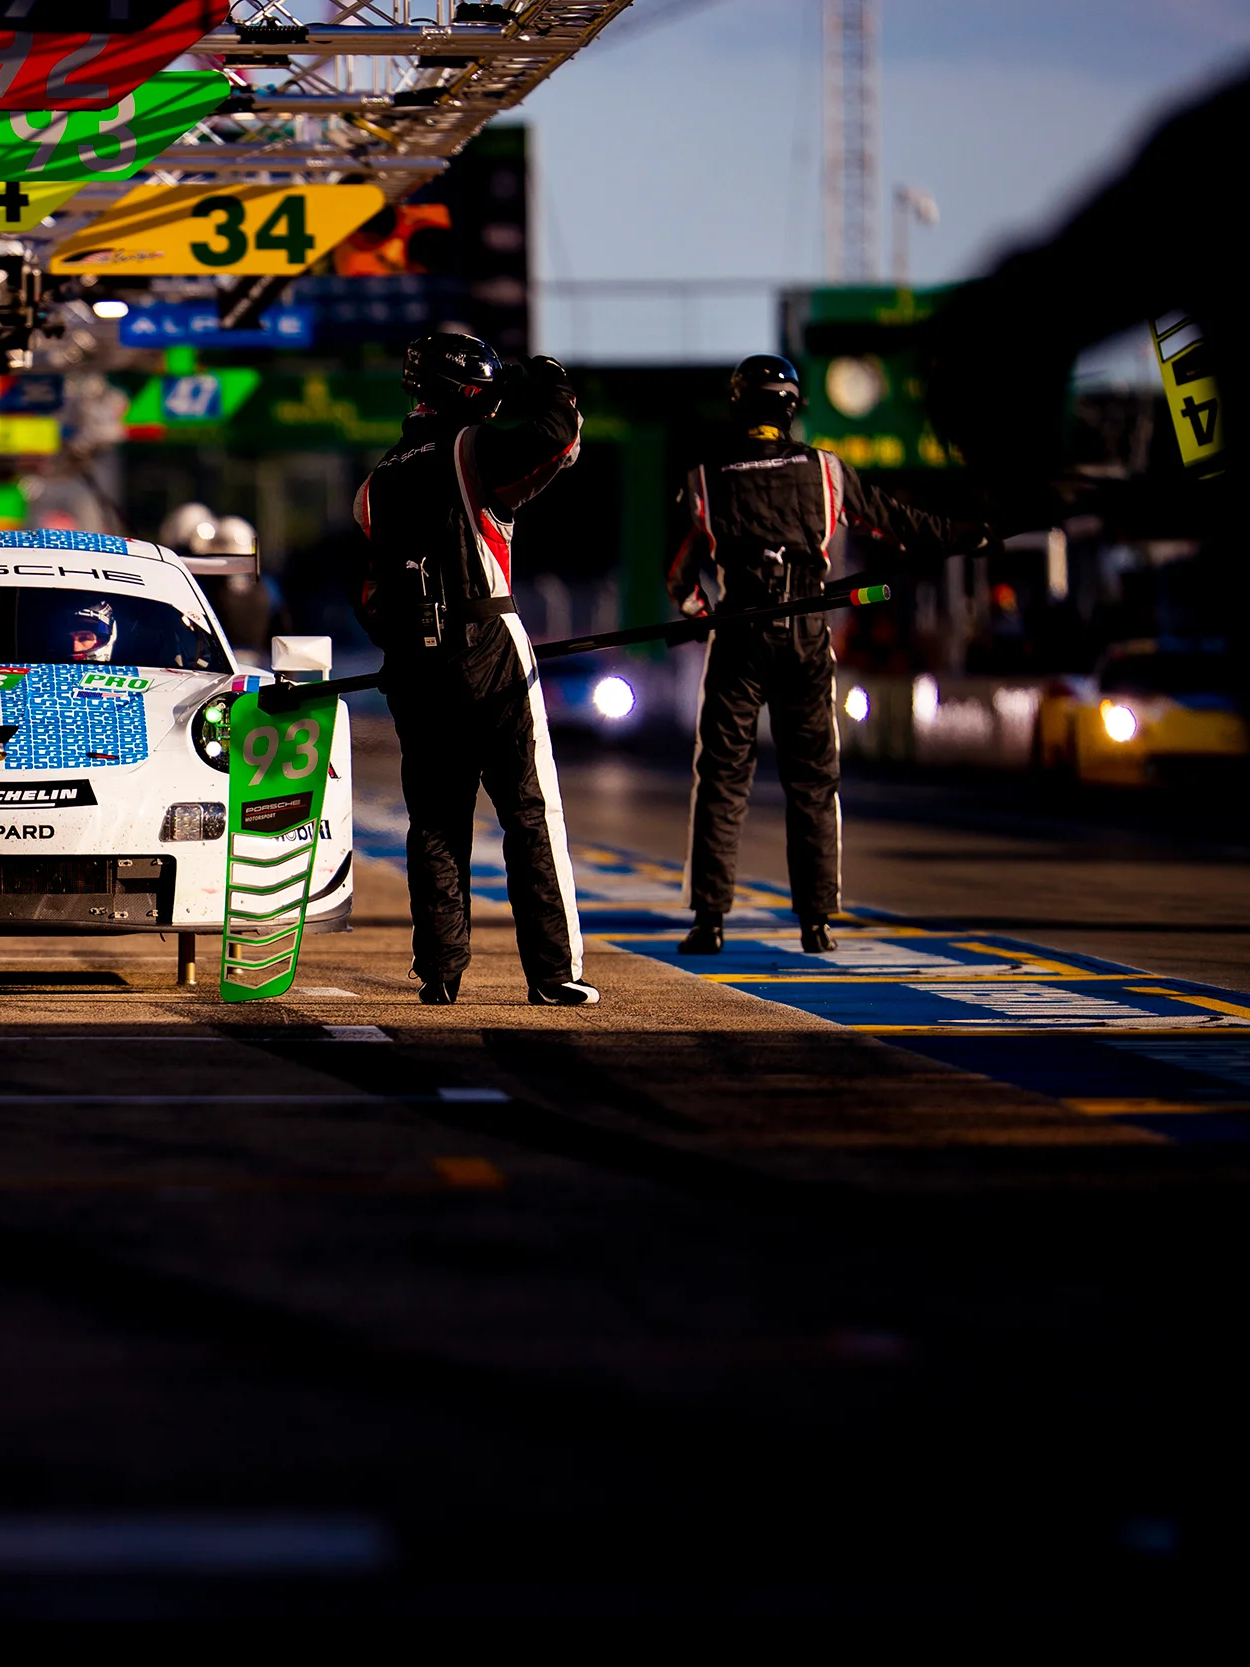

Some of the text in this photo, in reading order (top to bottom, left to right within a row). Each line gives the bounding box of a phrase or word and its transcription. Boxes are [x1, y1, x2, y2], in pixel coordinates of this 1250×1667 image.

[9, 92, 138, 173] 93
[190, 195, 315, 267] 34
[85, 673, 149, 690] PRO
[243, 719, 320, 786] 93
[245, 799, 301, 813] PORSCHE
[245, 812, 276, 823] MOTORSPORT
